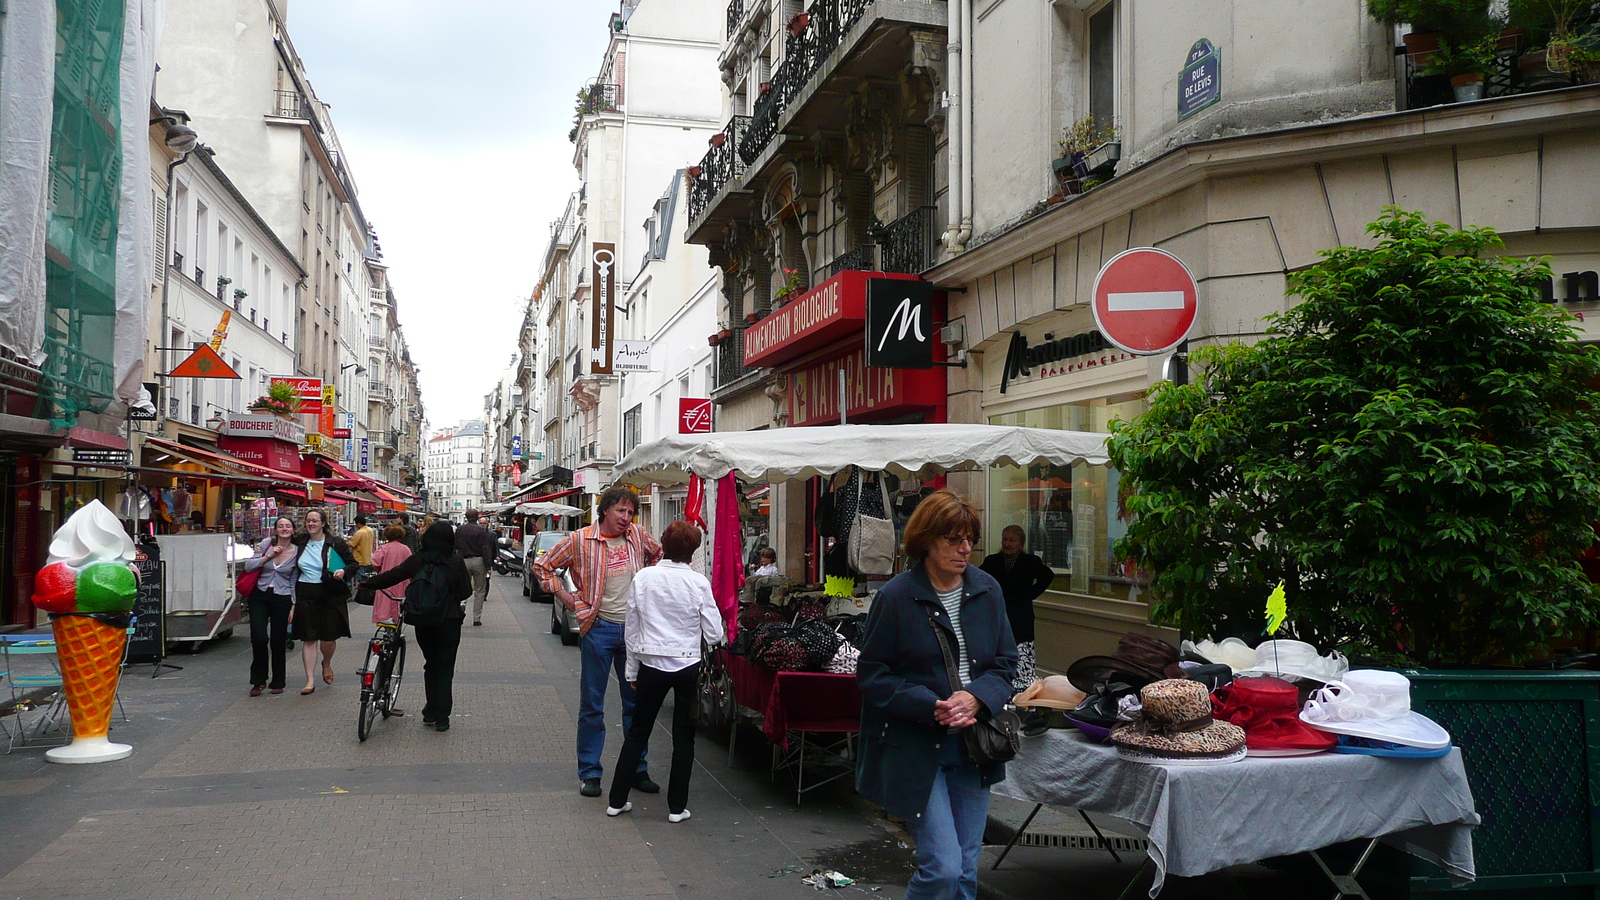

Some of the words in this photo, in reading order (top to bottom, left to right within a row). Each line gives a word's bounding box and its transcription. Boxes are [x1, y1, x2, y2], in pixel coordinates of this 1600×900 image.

[1192, 65, 1205, 82] RUE
[1185, 84, 1194, 98] DE
[1194, 75, 1212, 93] LEVIS
[745, 310, 791, 359] ALIMENTATION
[793, 281, 839, 335] BIOLOGIQUE
[811, 349, 894, 419] NATURALIA
[230, 420, 273, 431] BOUCHERIE
